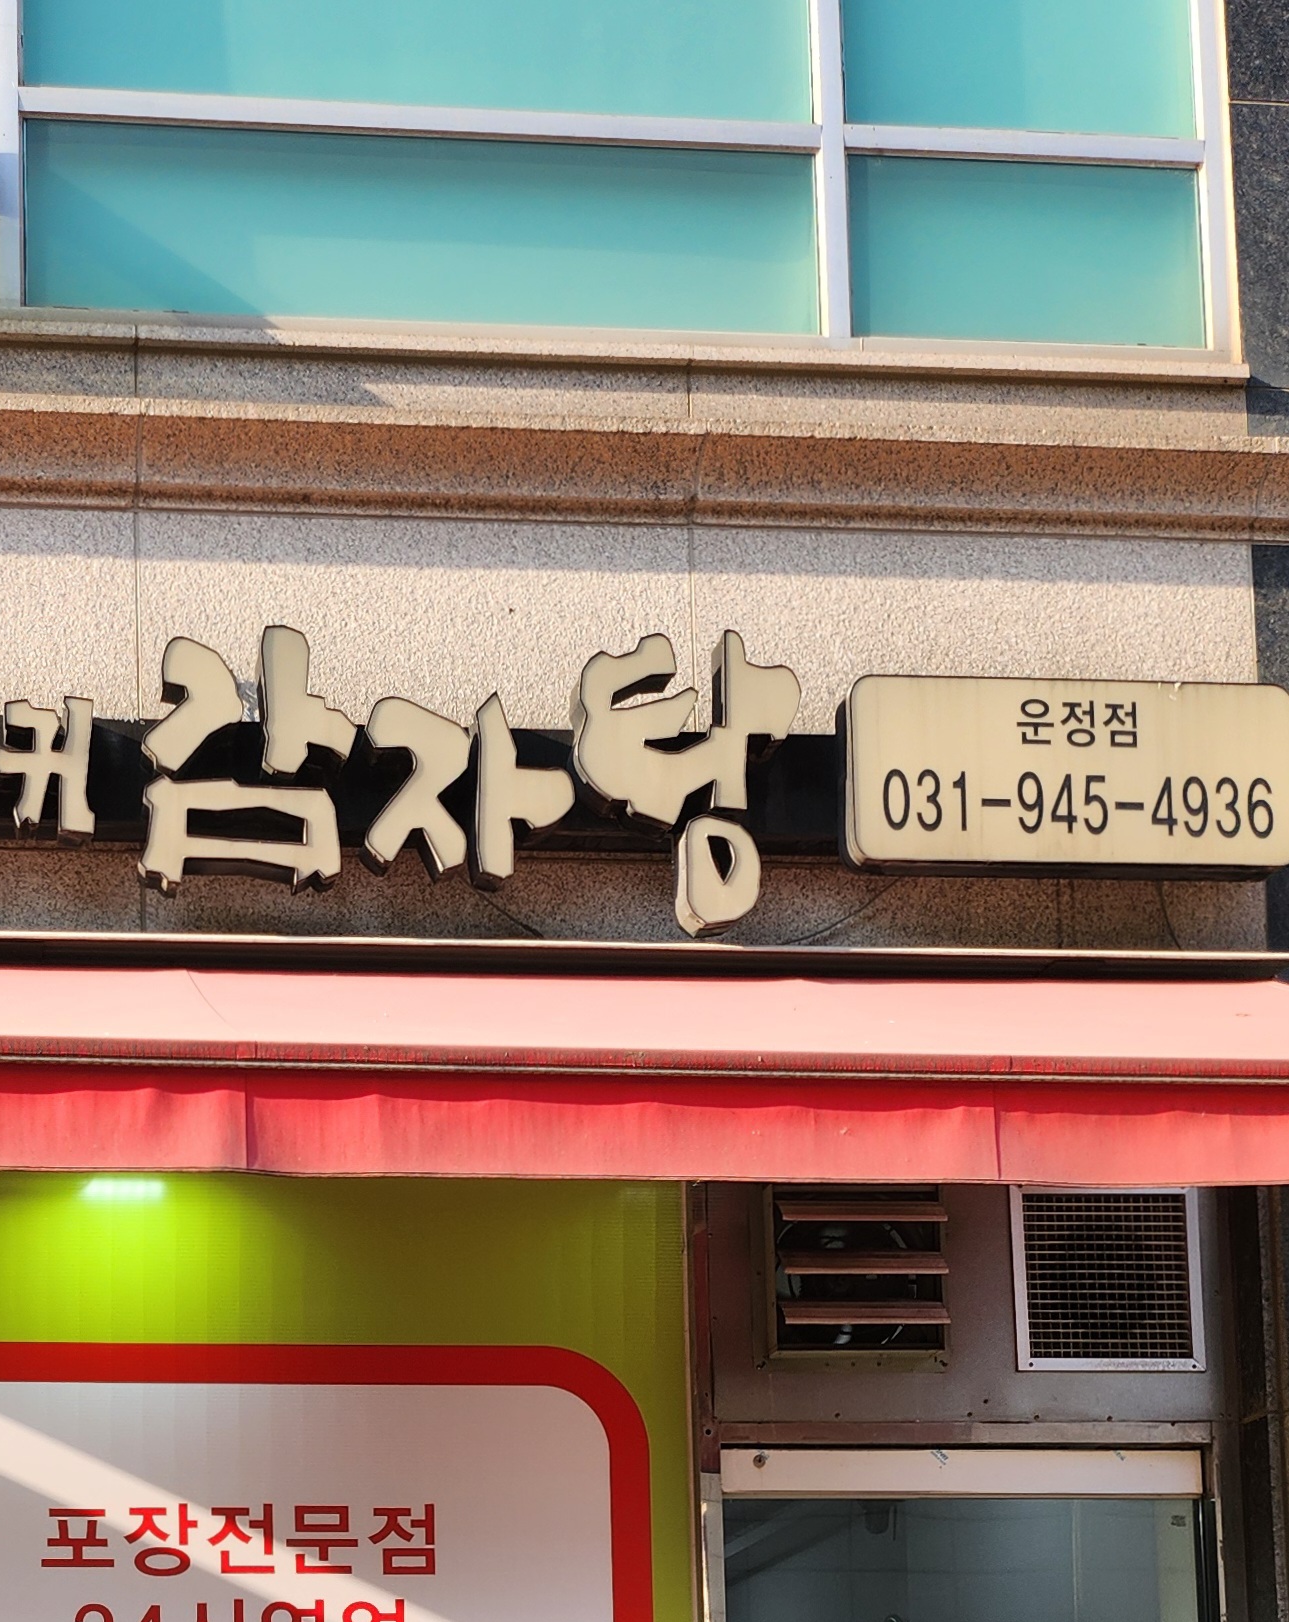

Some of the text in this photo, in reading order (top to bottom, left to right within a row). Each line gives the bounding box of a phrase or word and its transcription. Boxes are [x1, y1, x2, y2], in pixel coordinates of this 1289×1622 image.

[1016, 697, 1139, 748] 운정점
[138, 625, 801, 937] 감자탕
[882, 768, 1275, 839] 031-945-4936
[41, 1503, 438, 1577] 포장전문점
